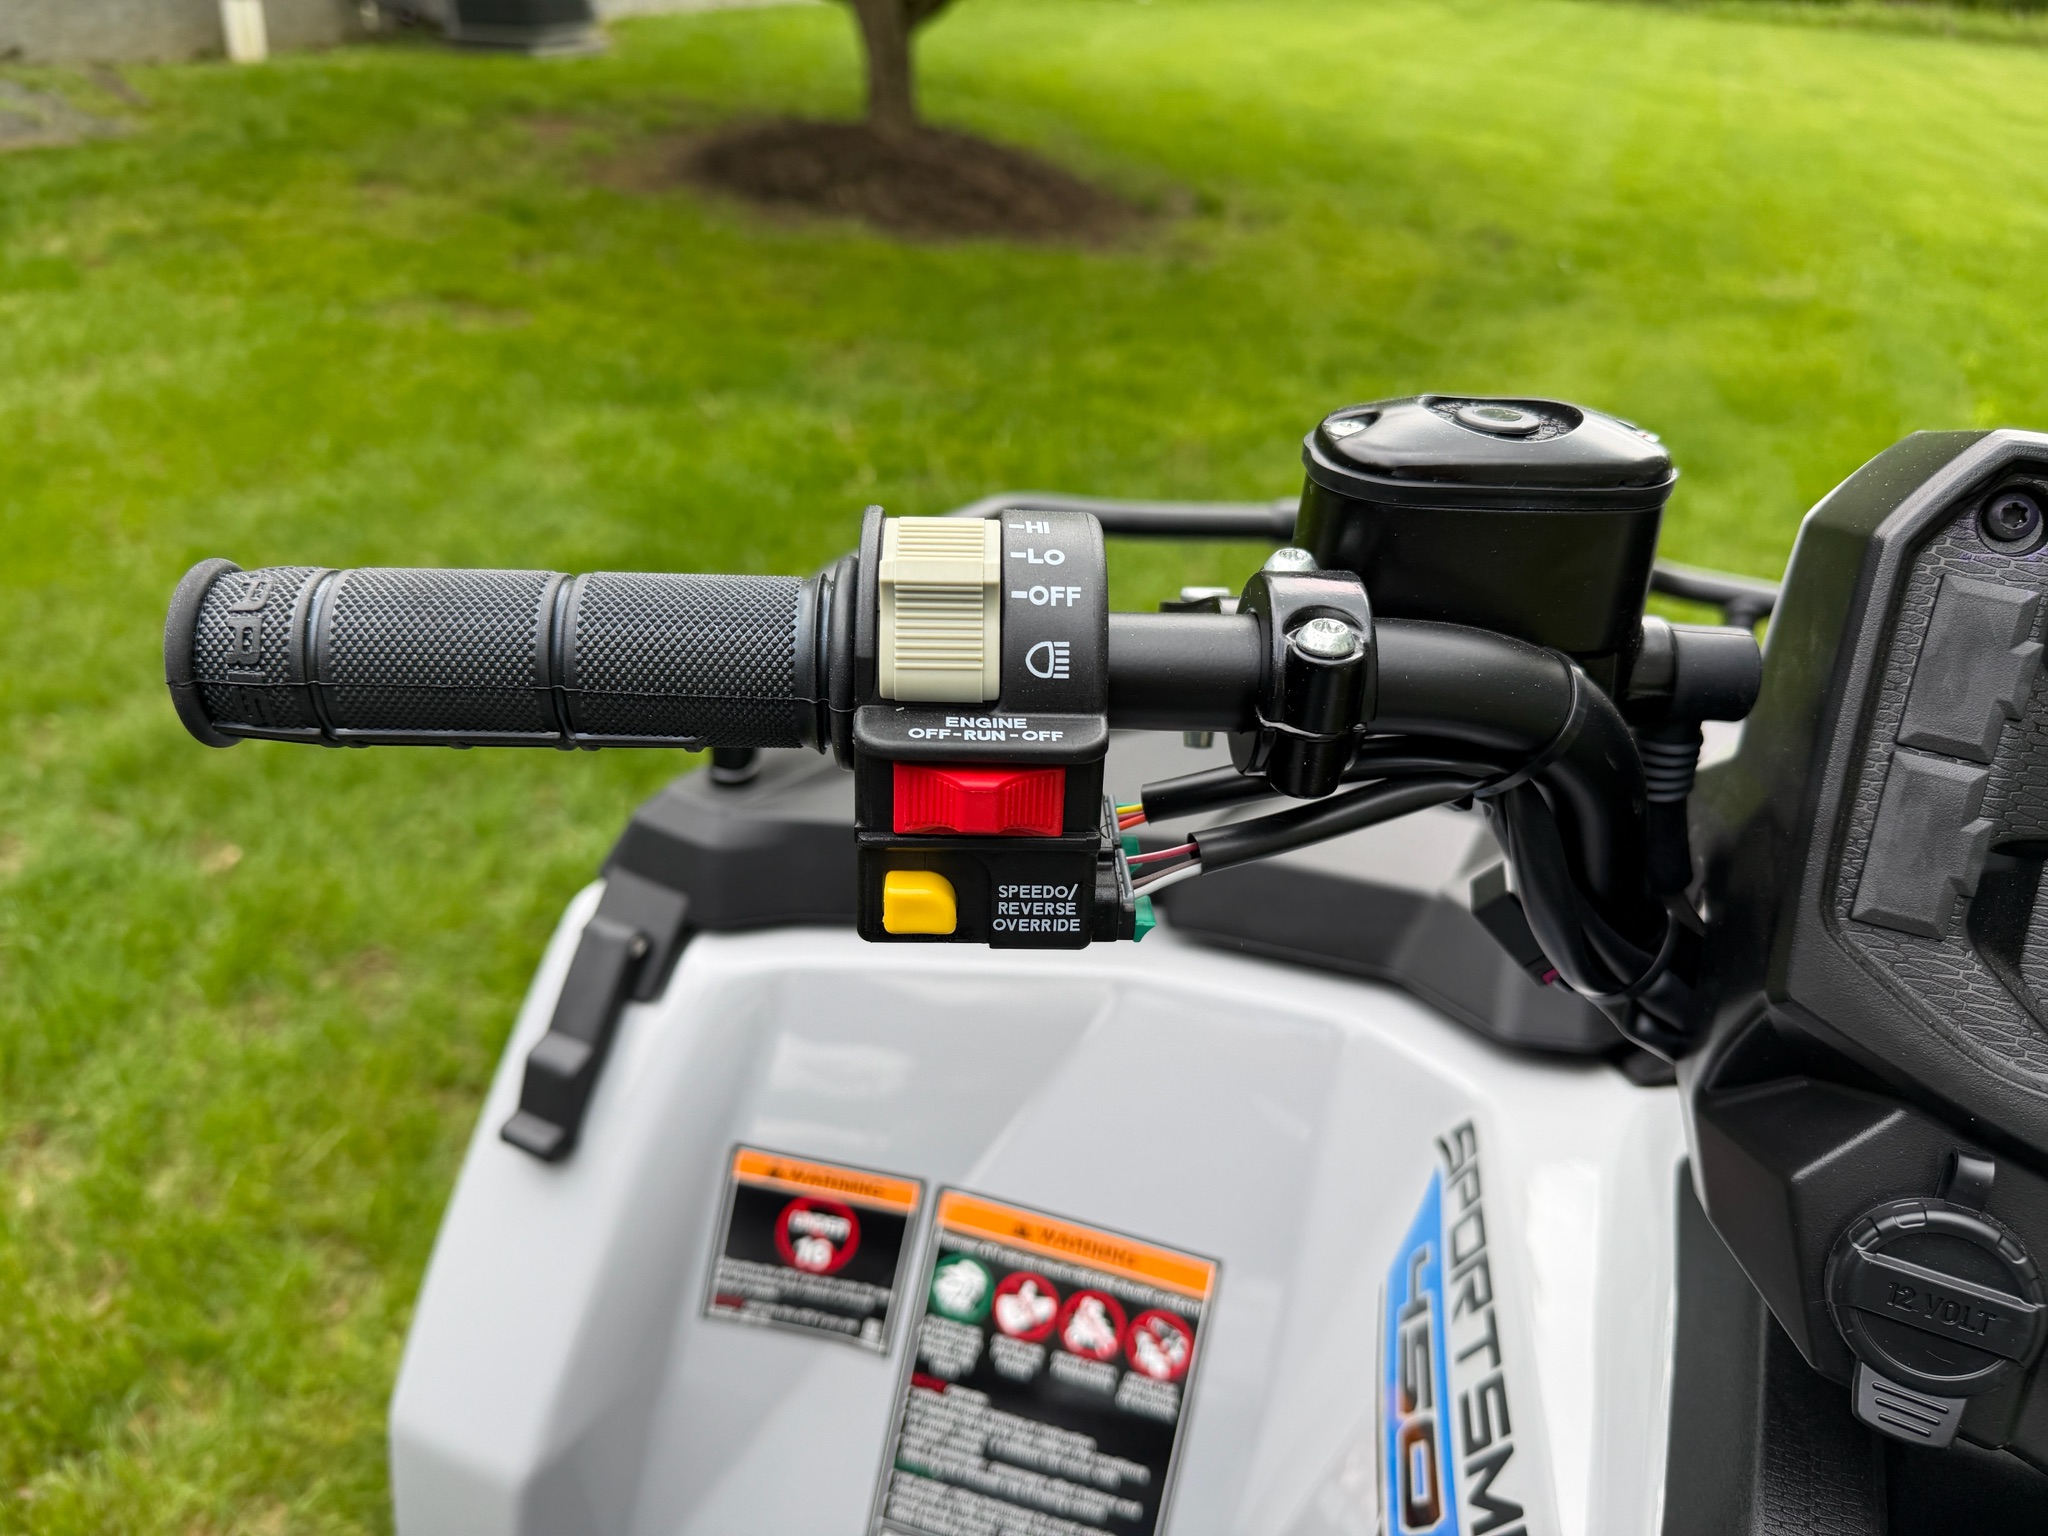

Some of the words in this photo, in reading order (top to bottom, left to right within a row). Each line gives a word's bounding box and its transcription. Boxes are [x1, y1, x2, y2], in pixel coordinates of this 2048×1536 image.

[945, 716, 1028, 729] ENGINE
[998, 883, 1079, 900] SPEEDO/
[998, 901, 1077, 916] REVERSE
[992, 918, 1081, 932] OVERRIDE
[1886, 1282, 1917, 1313] 12
[1924, 1293, 1997, 1336] VOLT
[1434, 1117, 1529, 1536] SPORTSM
[1398, 1241, 1446, 1531] 450
